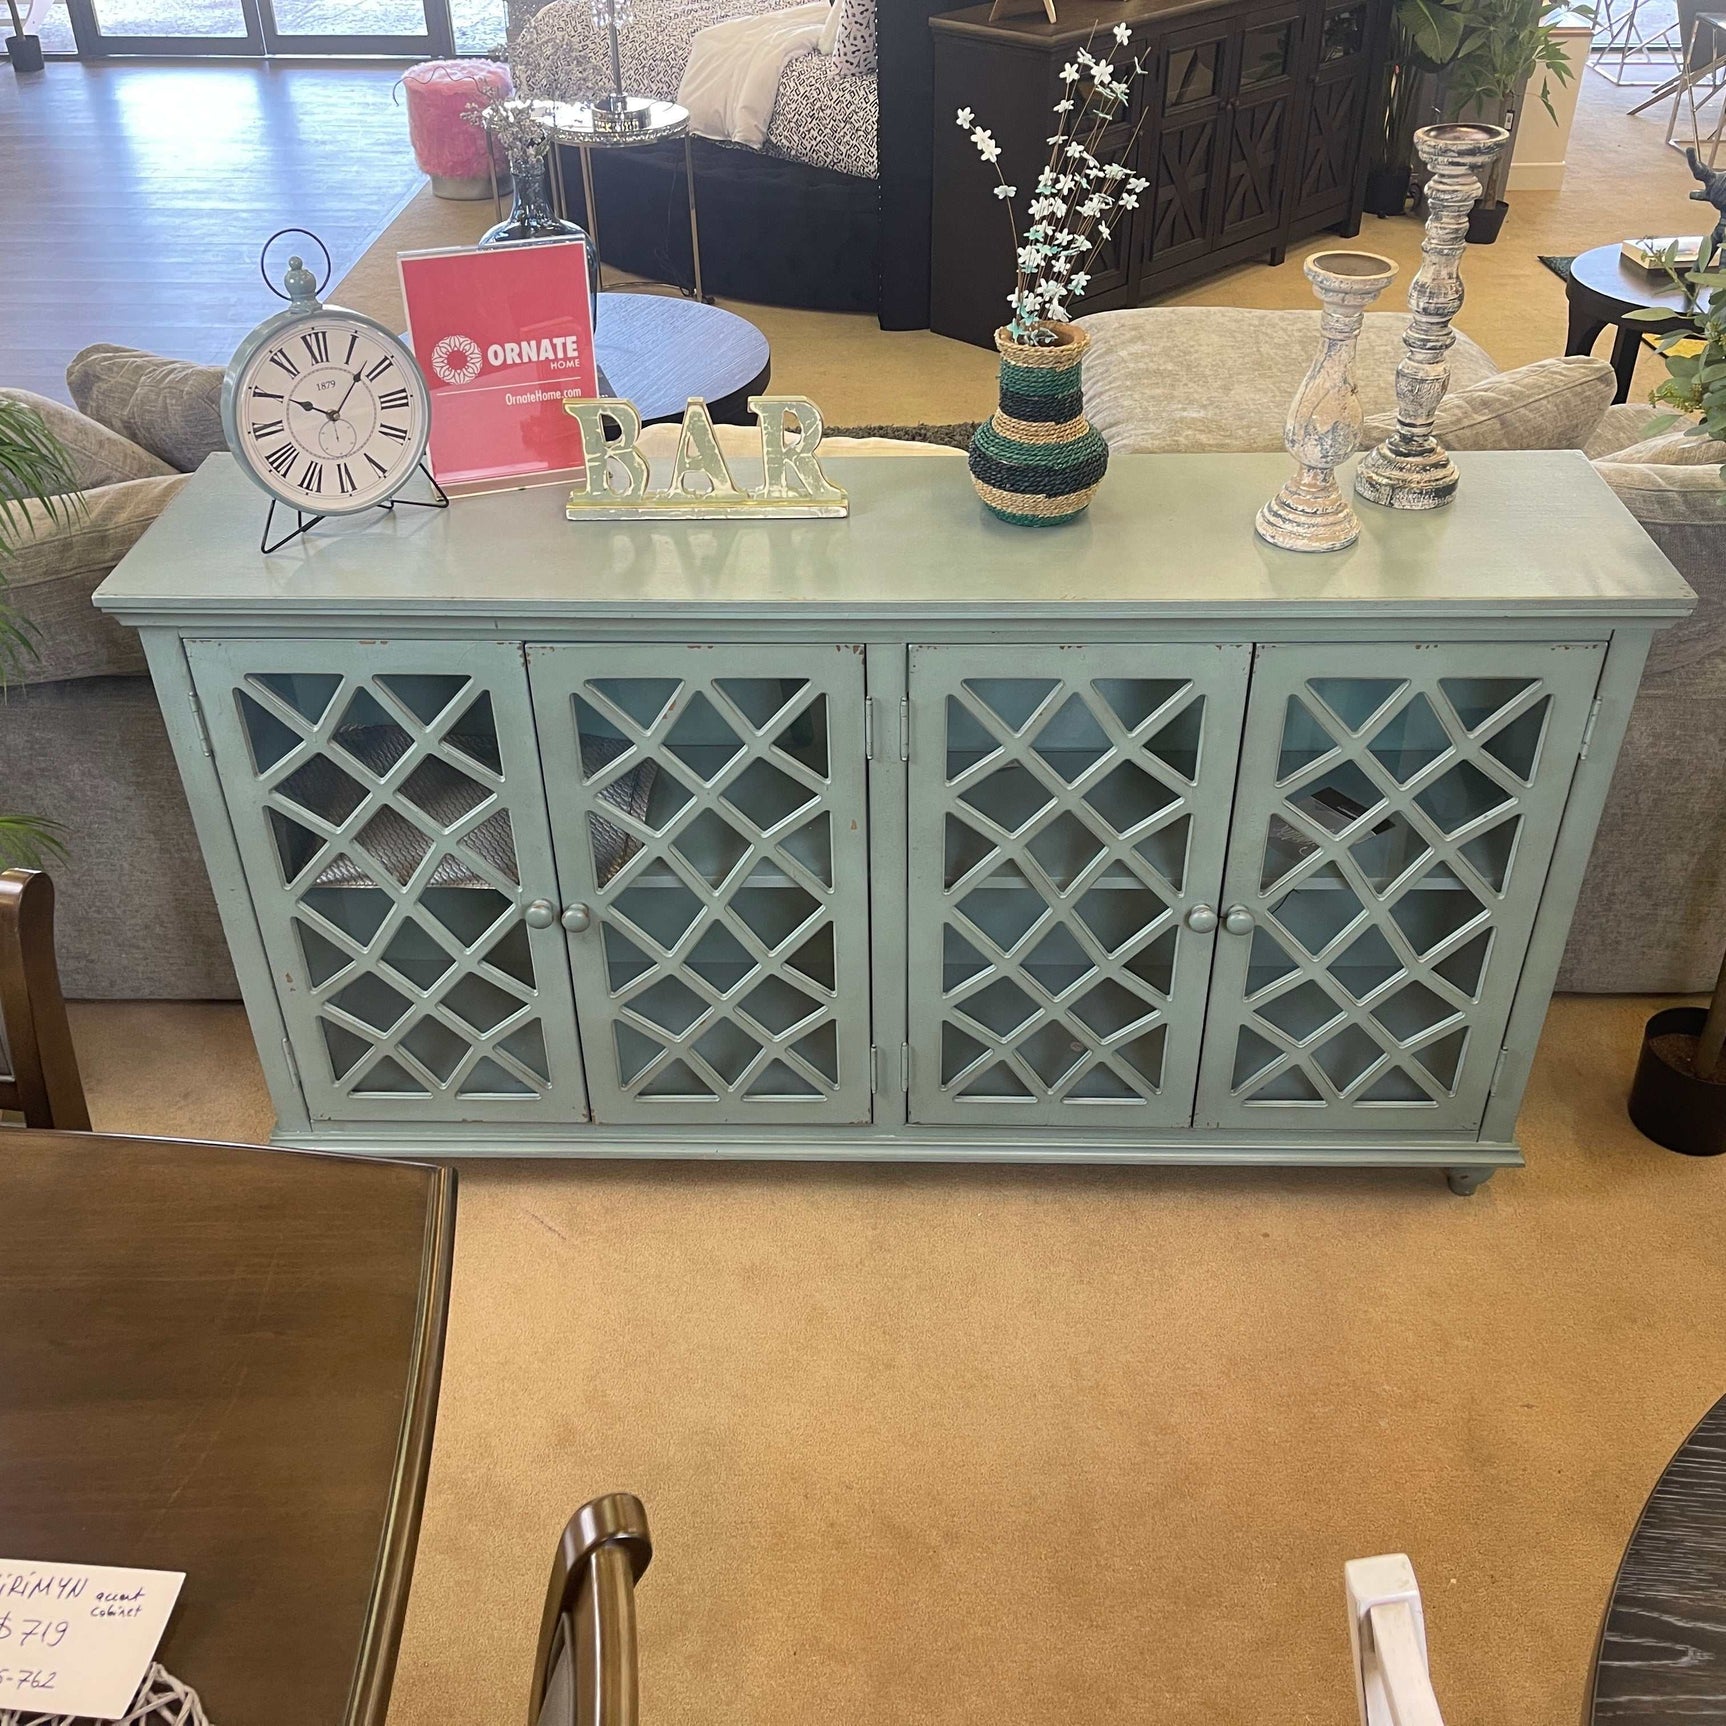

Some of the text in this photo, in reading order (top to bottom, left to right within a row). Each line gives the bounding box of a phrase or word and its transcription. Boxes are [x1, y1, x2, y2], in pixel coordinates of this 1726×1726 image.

[300, 331, 330, 366] XII
[344, 334, 359, 365] I
[487, 335, 579, 366] ORNATE
[365, 355, 394, 383] II
[550, 358, 581, 370] HOME
[316, 379, 336, 392] 1879
[378, 387, 410, 410] III
[505, 388, 582, 406] OrnateHome.com
[562, 396, 848, 504] BAR
[297, 460, 323, 494] VII
[336, 462, 358, 494] VI
[364, 452, 388, 479] V
